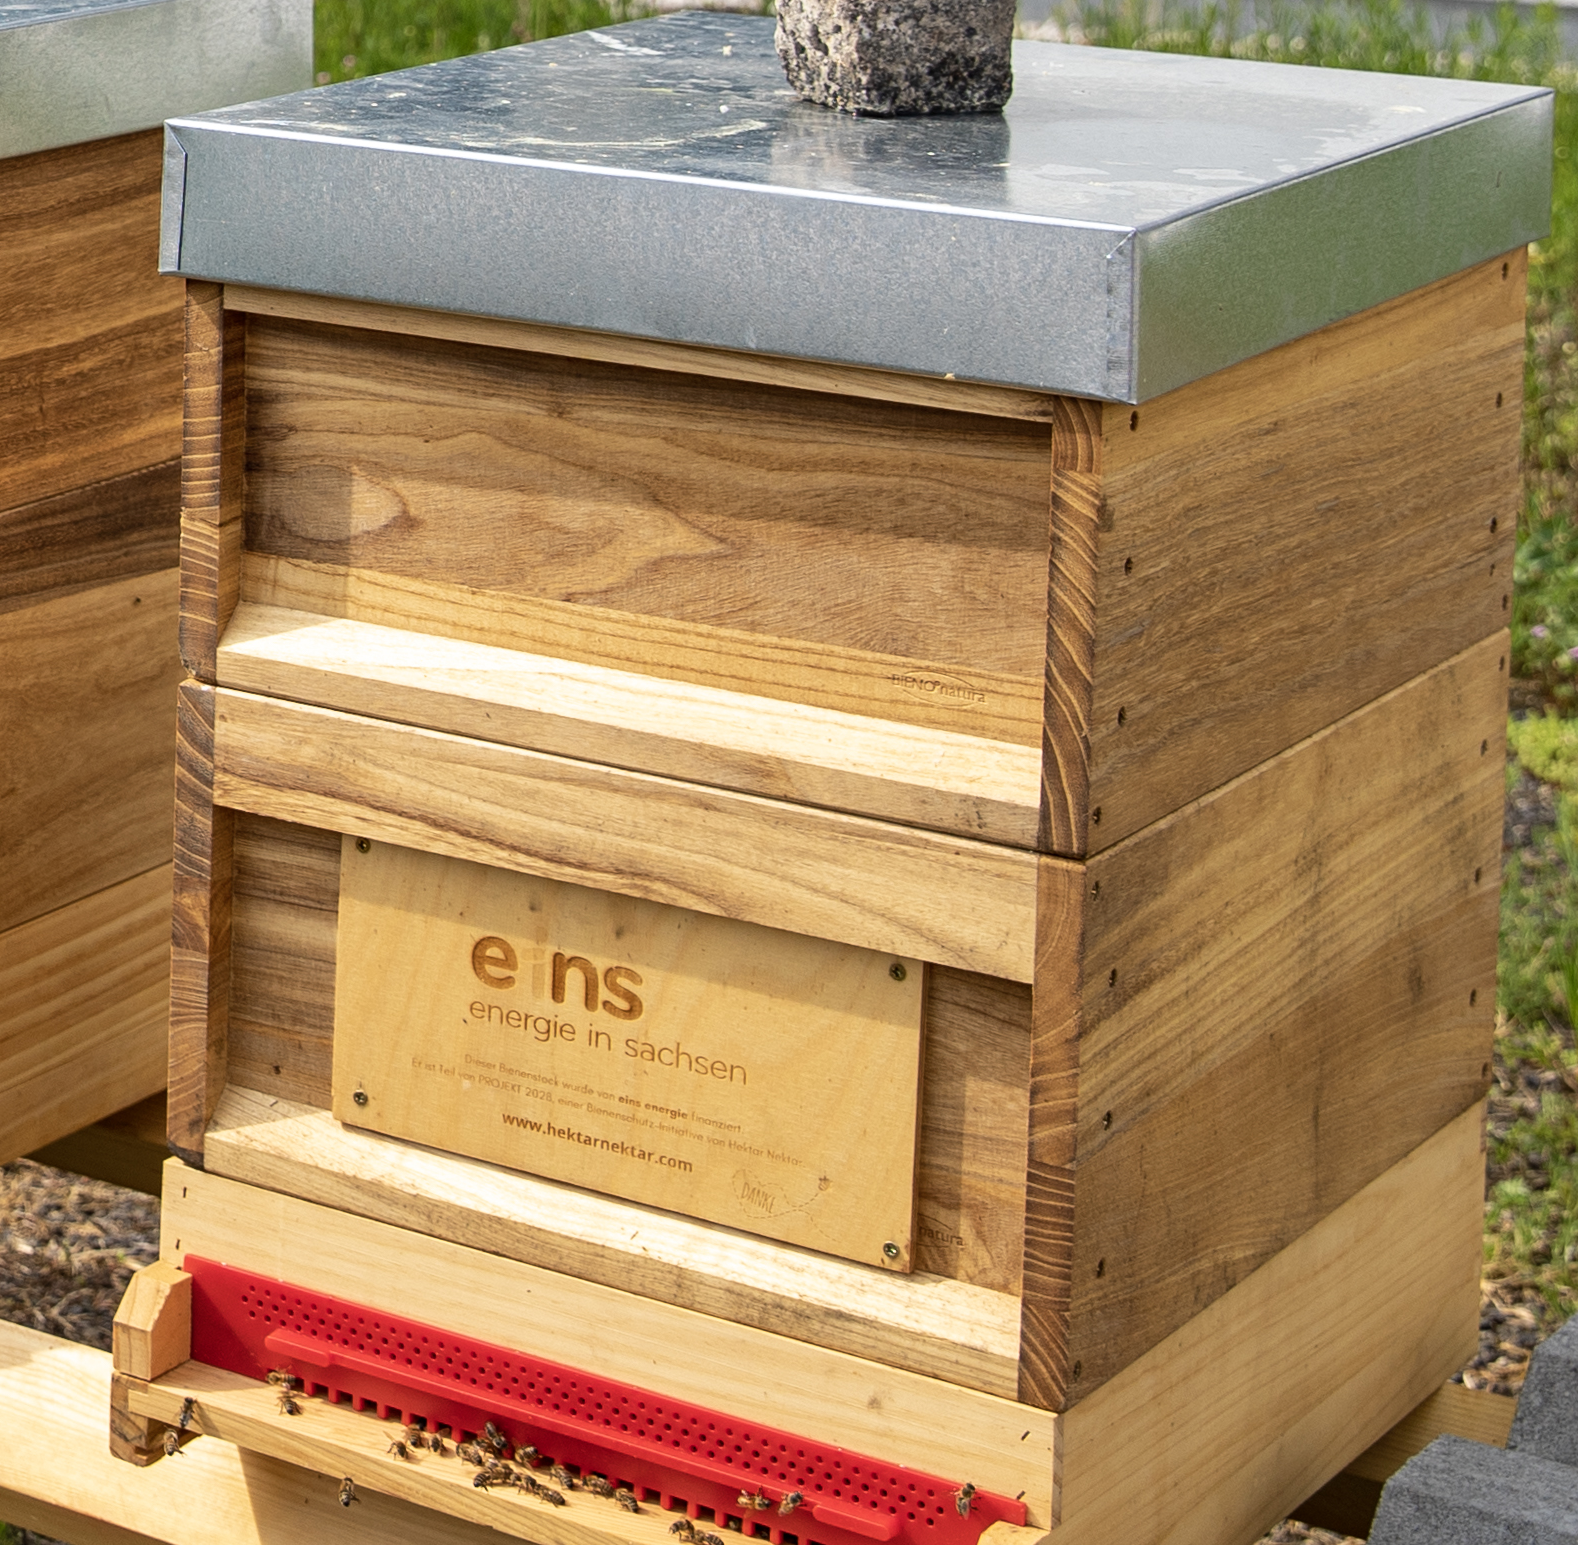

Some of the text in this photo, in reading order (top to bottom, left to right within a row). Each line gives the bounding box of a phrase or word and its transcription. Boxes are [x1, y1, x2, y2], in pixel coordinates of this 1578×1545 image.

[469, 1001, 747, 1086] energie in sachsen
[411, 1057, 422, 1069] Er
[425, 1062, 437, 1073] ist
[439, 1063, 456, 1077] Teil
[458, 1070, 477, 1083] von
[478, 1074, 524, 1094] PROJEKT
[525, 1086, 556, 1105] 2028,
[557, 1096, 585, 1110] einer
[586, 1102, 704, 1142] Bienenschutz-Initiative
[706, 1136, 727, 1148] von
[728, 1139, 764, 1158] Hektar
[464, 1053, 497, 1070] Dieser
[499, 1062, 559, 1087] Bienenstock
[561, 1079, 595, 1096] wurde
[596, 1090, 617, 1102] von
[618, 1093, 642, 1108] eins
[644, 1101, 689, 1120] energie
[502, 1112, 693, 1174] www.hektarnektar.com
